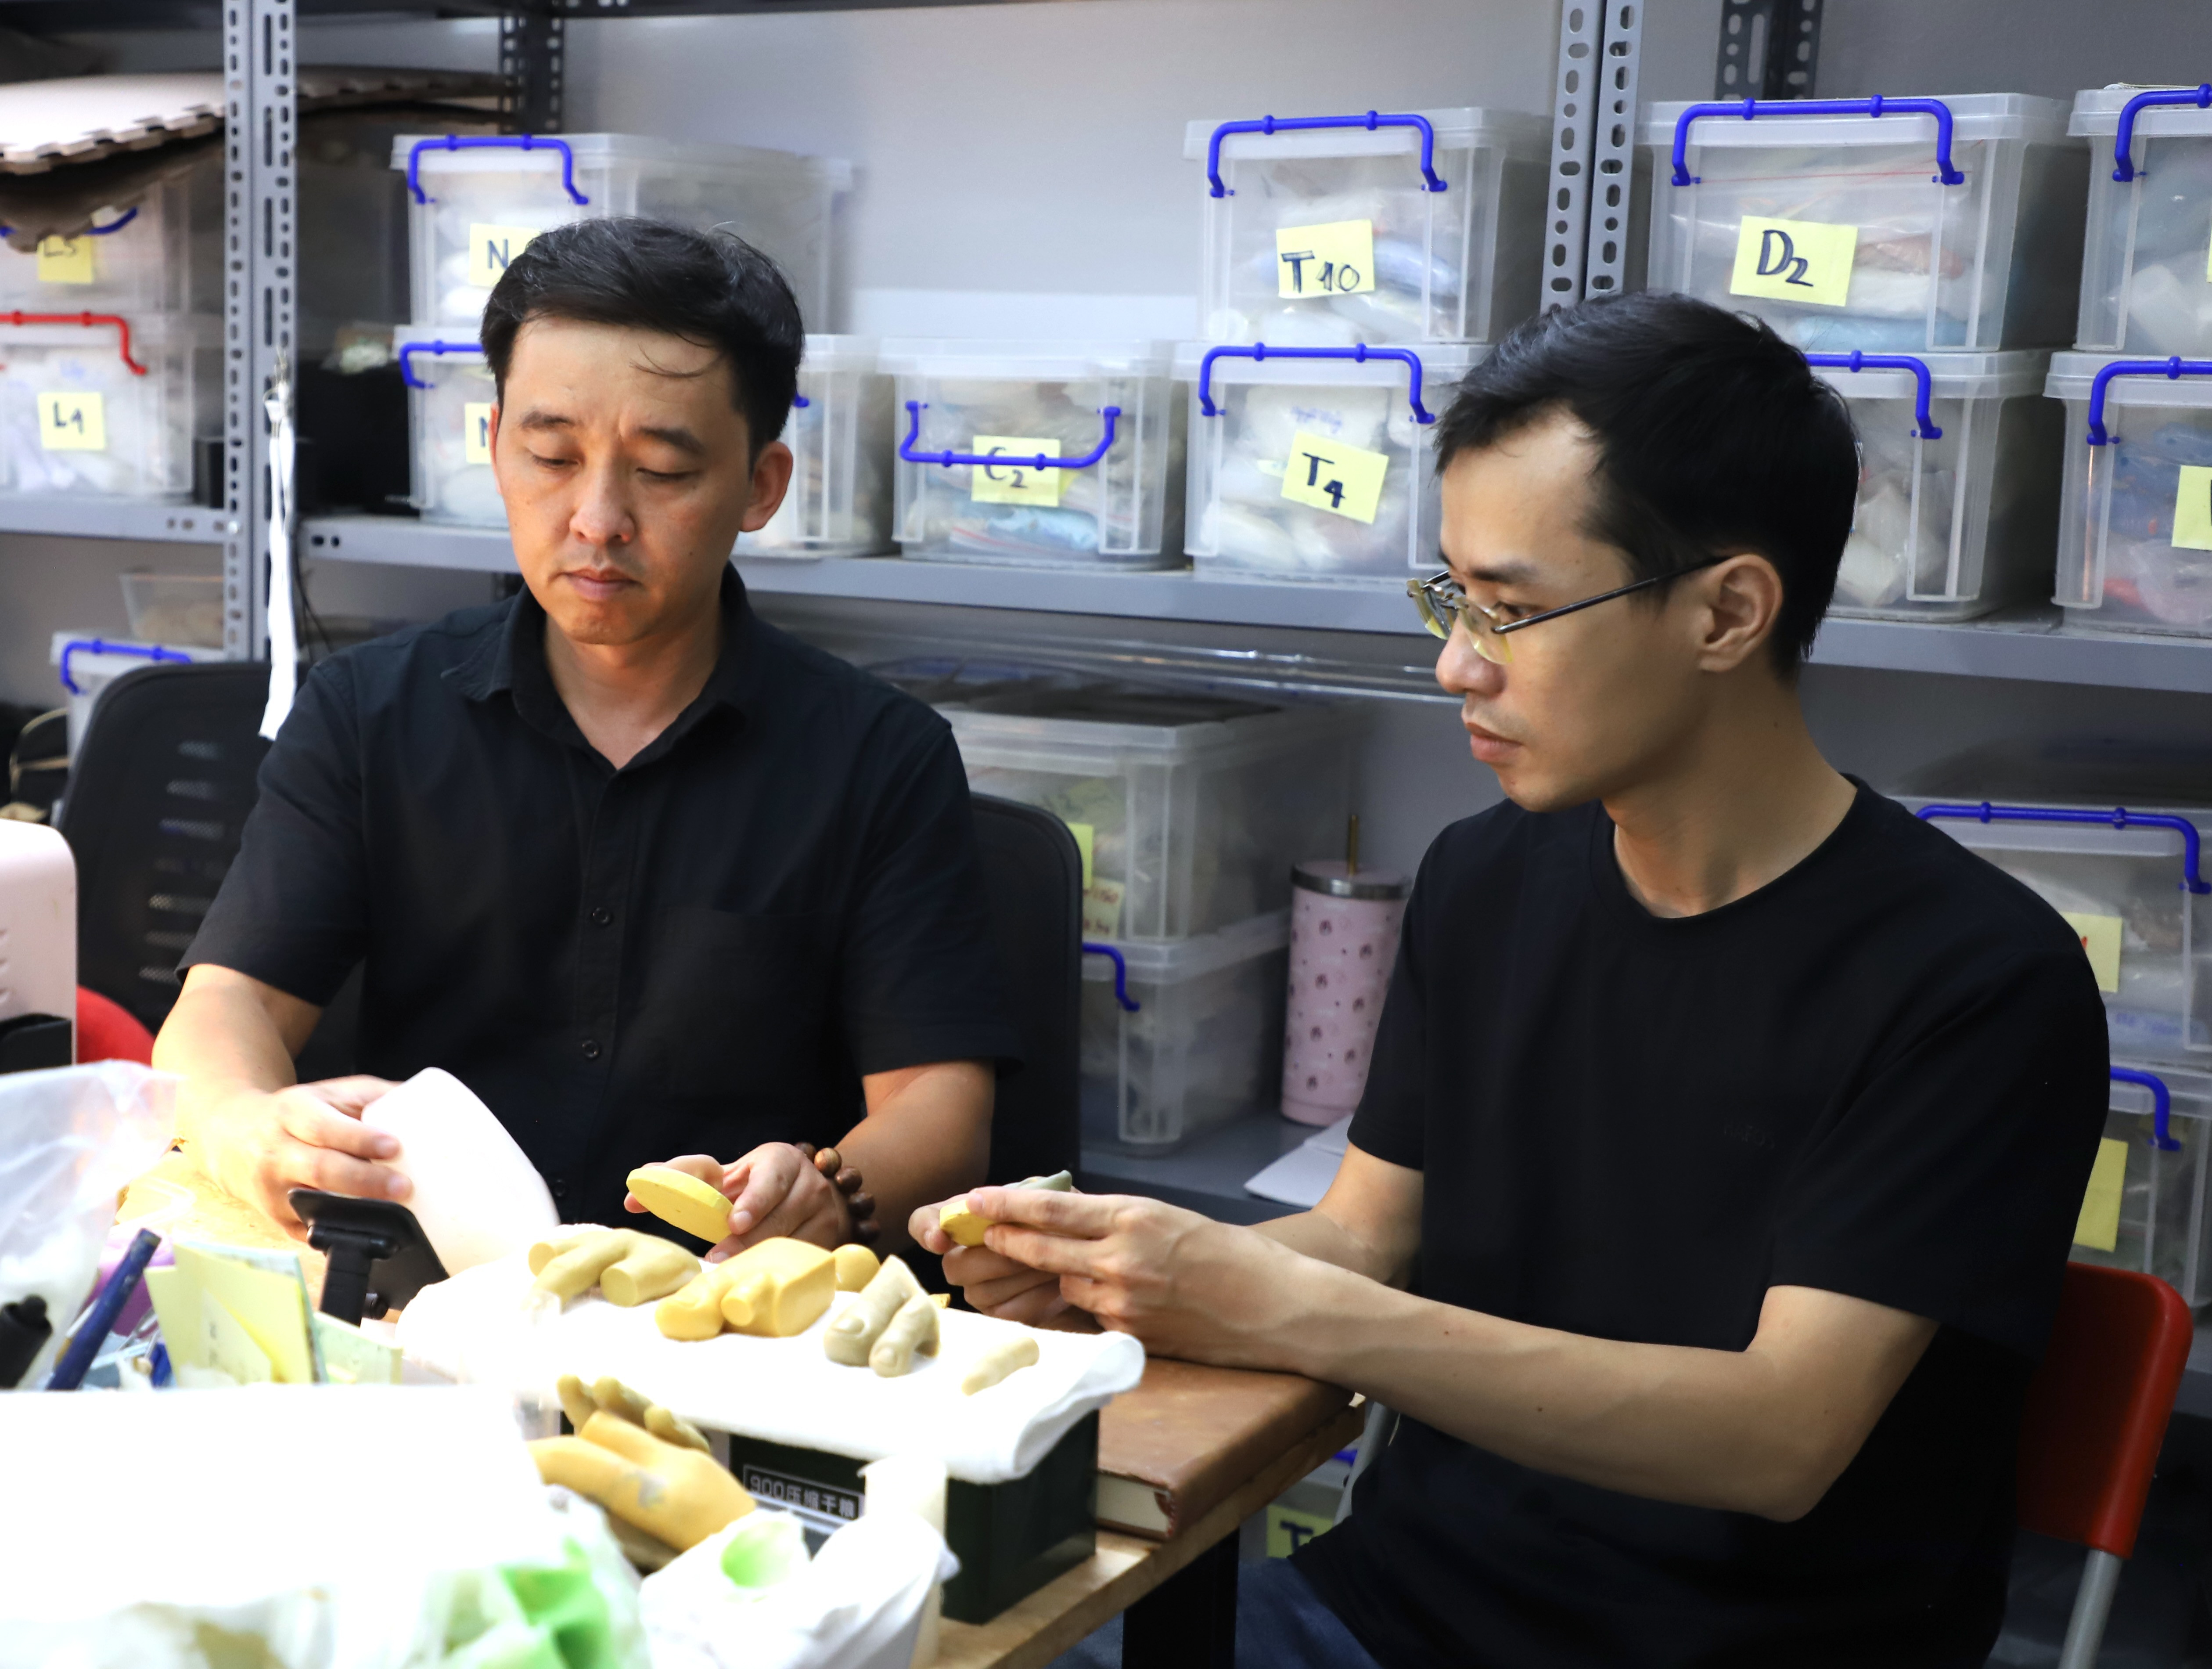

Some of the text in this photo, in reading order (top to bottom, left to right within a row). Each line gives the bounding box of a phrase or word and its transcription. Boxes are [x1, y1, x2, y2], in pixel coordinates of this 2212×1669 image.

[1280, 249, 1360, 294] T10
[1756, 229, 1813, 287] D2
[52, 400, 85, 435] L1
[983, 446, 1028, 489] C2
[1302, 452, 1345, 508] T4
